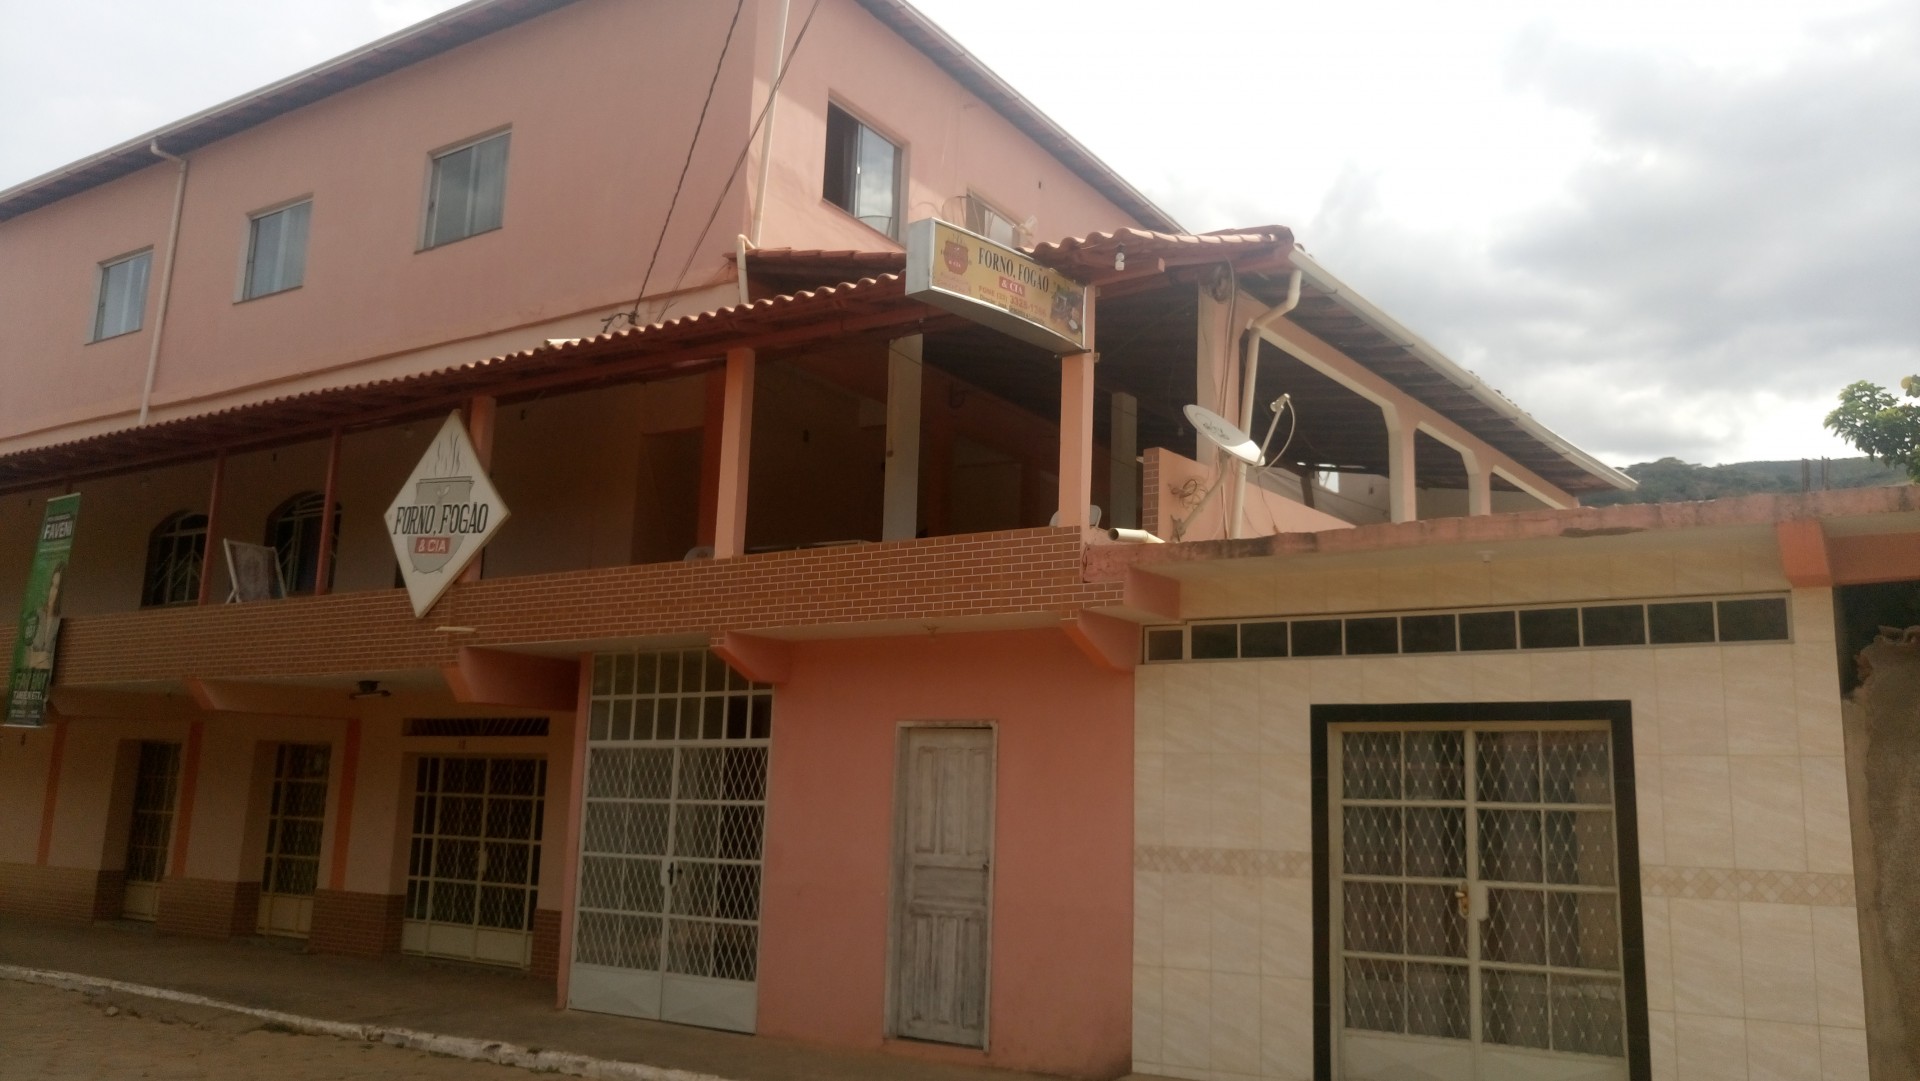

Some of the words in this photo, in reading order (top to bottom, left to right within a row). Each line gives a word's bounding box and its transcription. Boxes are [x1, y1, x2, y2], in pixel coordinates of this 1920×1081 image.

[978, 247, 1016, 279] FORNO,
[1001, 279, 1008, 289] &
[1009, 283, 1023, 295] CIA
[393, 506, 436, 536] FORNO,
[418, 539, 425, 552] &
[427, 539, 447, 552] CIA
